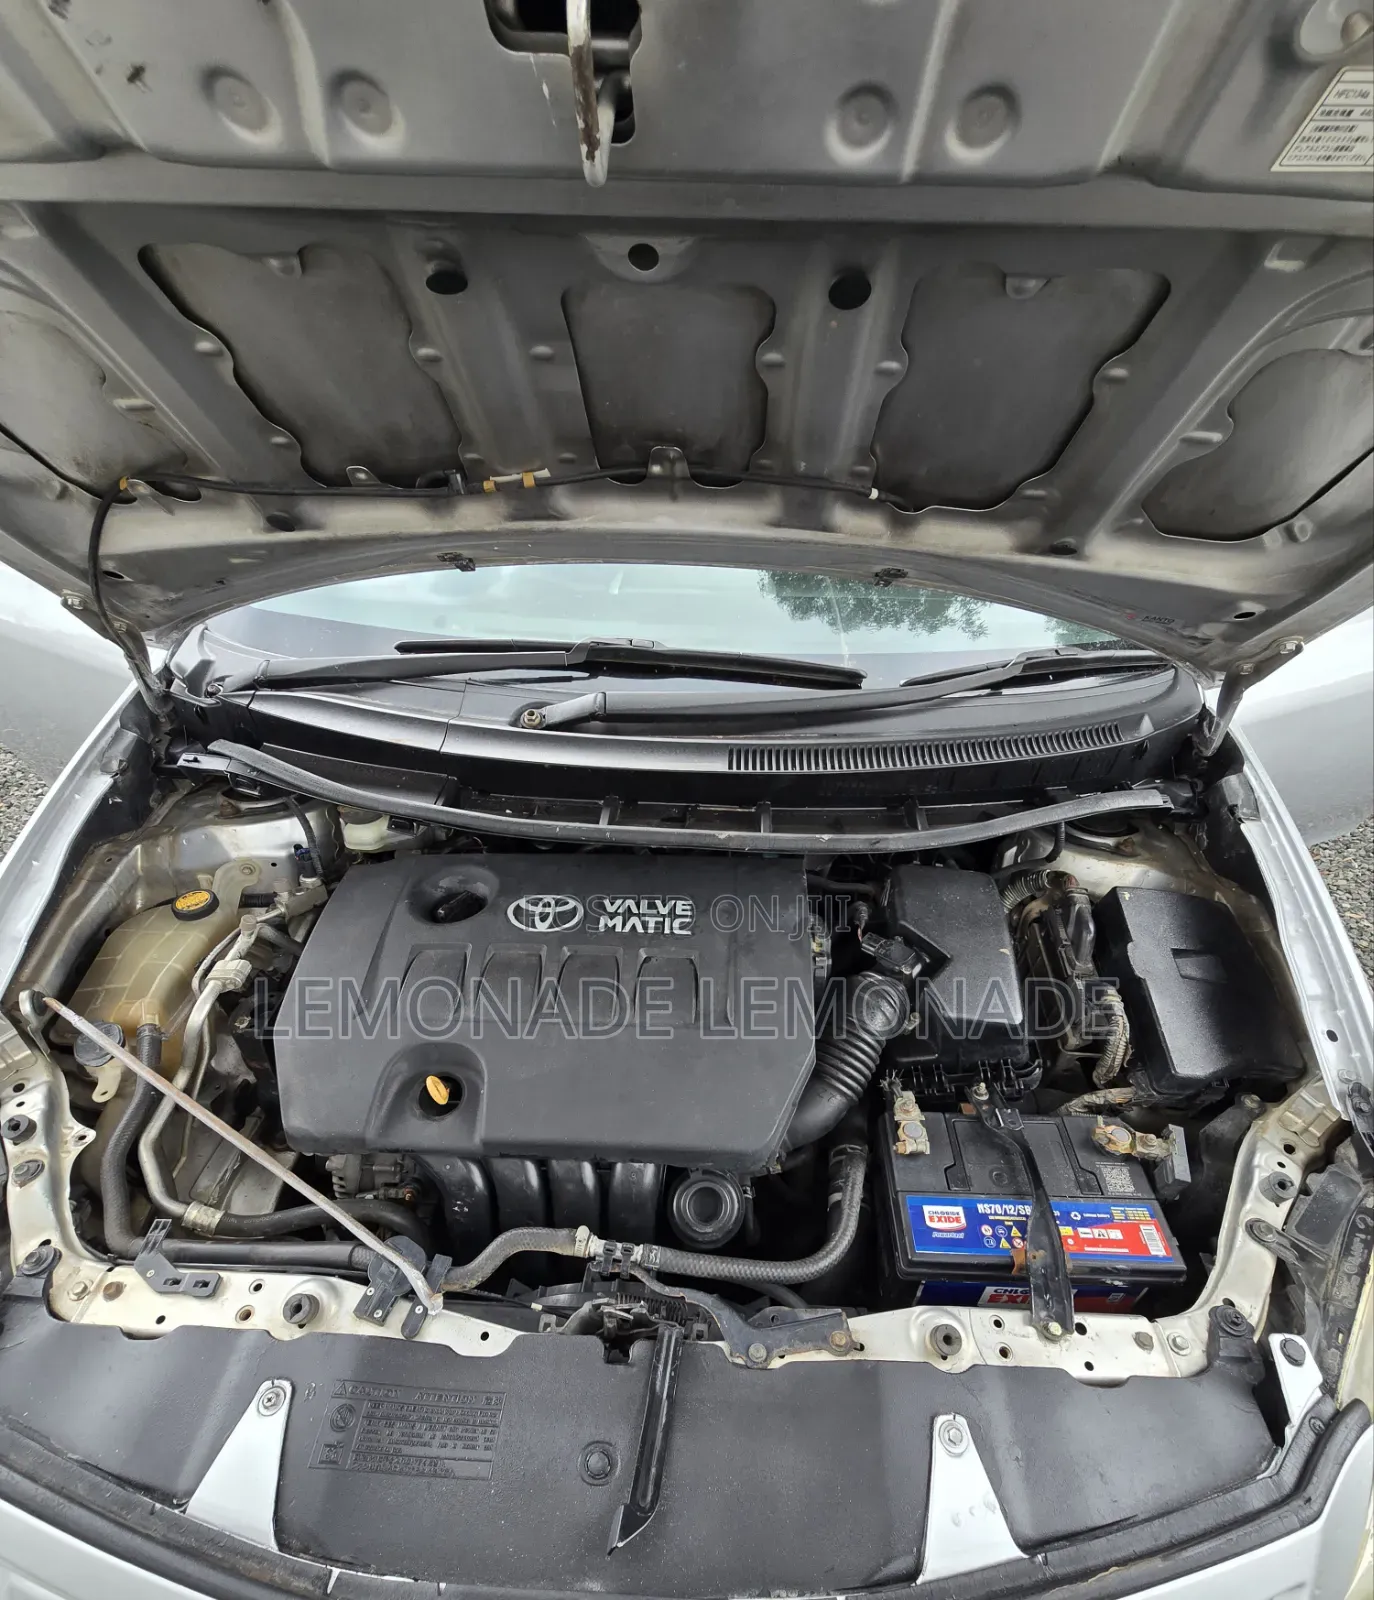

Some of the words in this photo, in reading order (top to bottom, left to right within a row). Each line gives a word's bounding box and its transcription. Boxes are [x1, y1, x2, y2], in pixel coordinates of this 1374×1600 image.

[602, 898, 693, 916] VALVE
[599, 915, 692, 935] MATIC
[977, 1203, 1032, 1216] NS70/12/SB
[929, 1216, 962, 1224] EXIDE
[987, 1294, 1028, 1303] EXI
